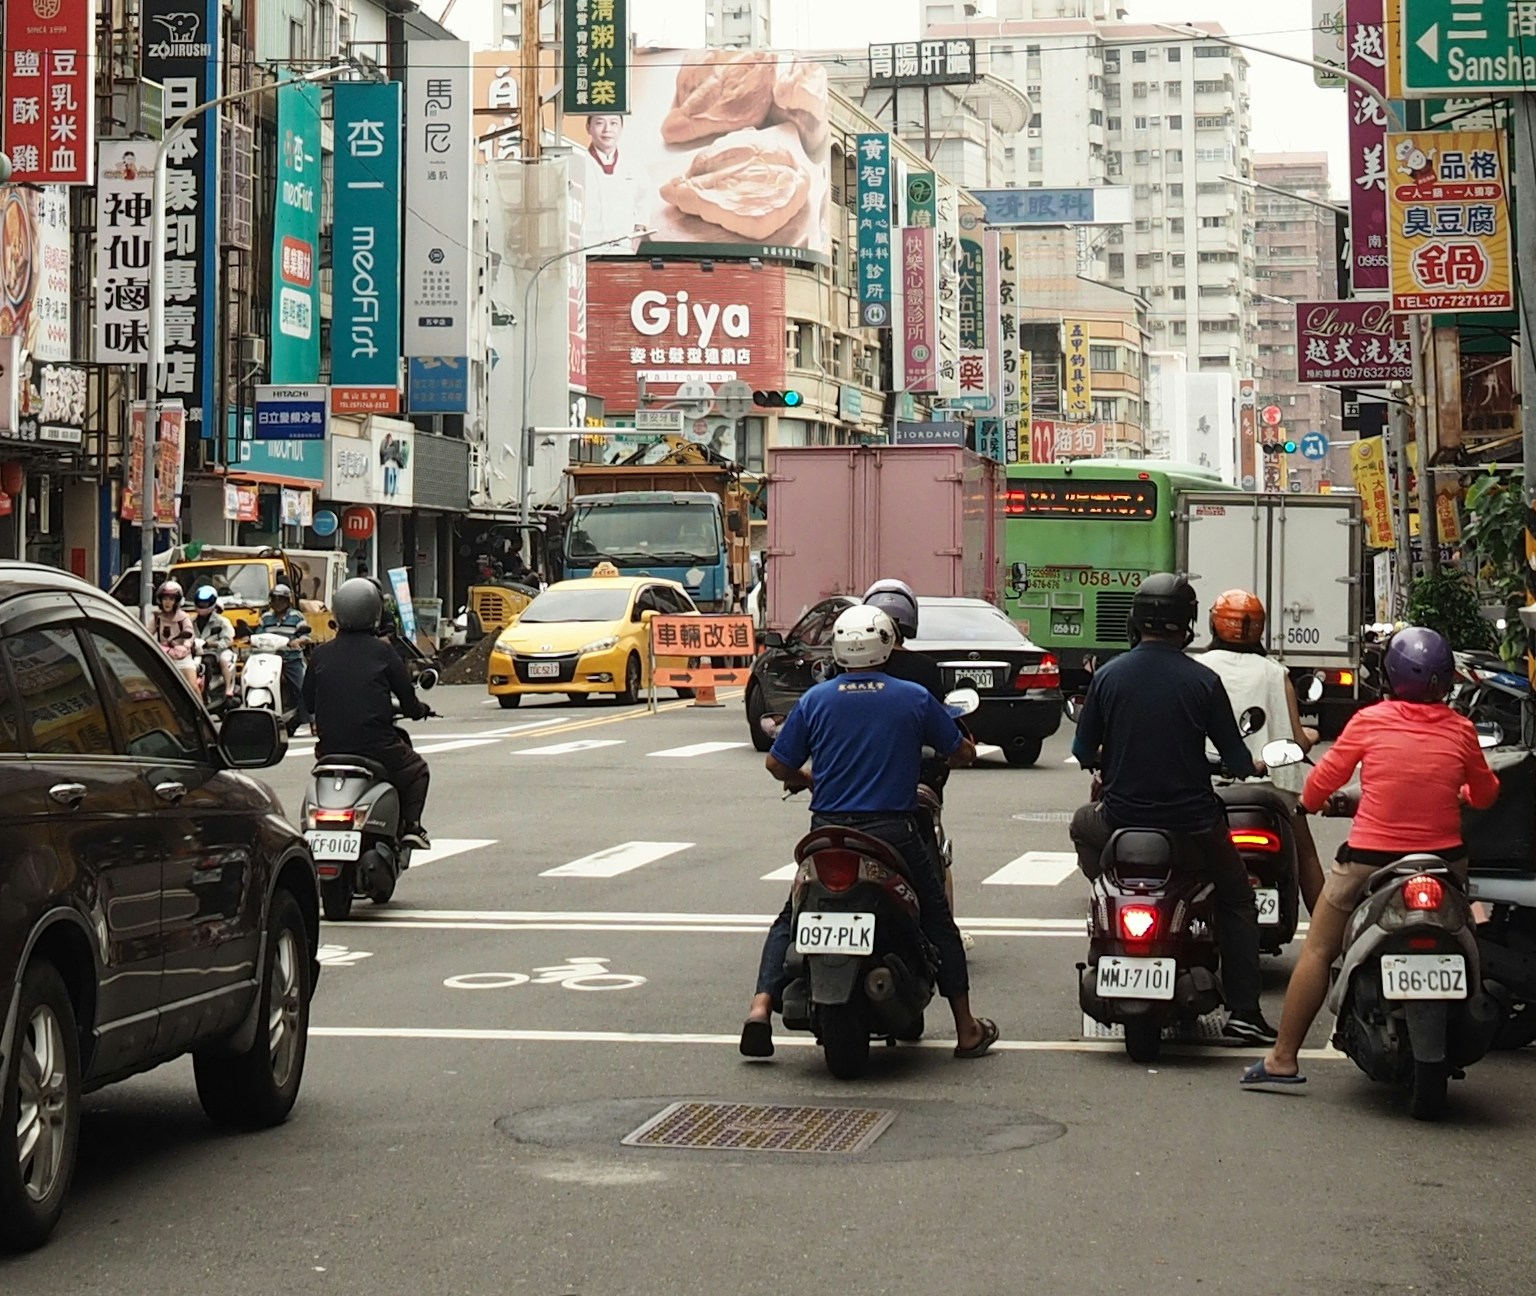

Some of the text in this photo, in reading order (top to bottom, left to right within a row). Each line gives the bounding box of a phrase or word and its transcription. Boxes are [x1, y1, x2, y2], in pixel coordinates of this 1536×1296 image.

[148, 40, 212, 59] ZOJIRUSHI
[869, 40, 971, 79] 胃腸肝膽
[11, 49, 41, 174] 鹽酥雞
[49, 48, 78, 173] 豆乳米血
[347, 118, 386, 191] 杏一
[859, 138, 887, 213] 黃智興
[1439, 151, 1498, 181] 品格
[156, 76, 200, 395] 日本象印專賣店
[1403, 205, 1496, 237] 臭豆腐
[865, 263, 884, 301] 診所
[1414, 242, 1485, 287] 鍋
[350, 226, 378, 360] medFirst
[905, 234, 925, 341] 快樂心靈診所
[630, 290, 750, 350] Giya
[959, 354, 984, 392] 藥
[1069, 323, 1086, 412] 五甲釣具中心
[271, 389, 310, 399] HITACHI
[1078, 570, 1142, 587] 058-V3
[656, 622, 750, 650] 車輛改道
[1286, 626, 1320, 645] 5600
